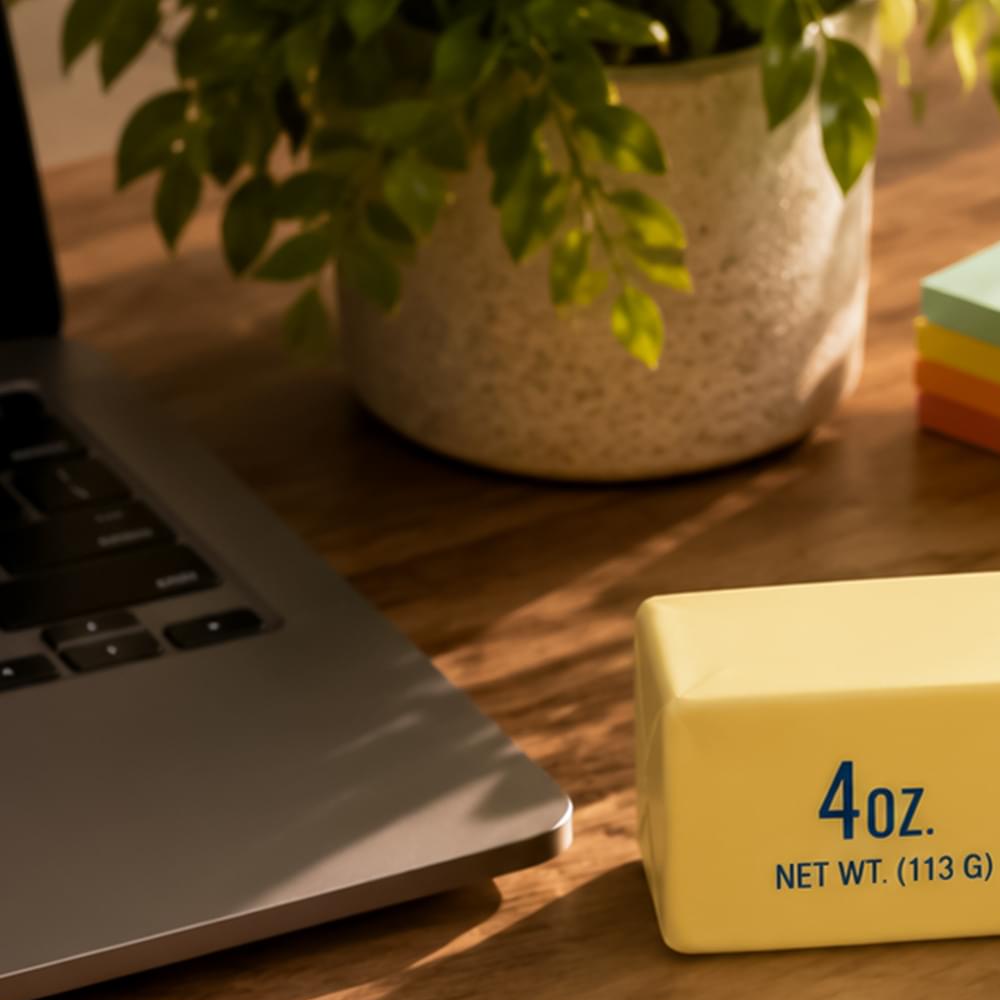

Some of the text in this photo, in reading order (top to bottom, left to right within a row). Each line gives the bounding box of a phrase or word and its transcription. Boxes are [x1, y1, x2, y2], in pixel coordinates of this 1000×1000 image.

[774, 851, 994, 890] NET WT. (113 G)
